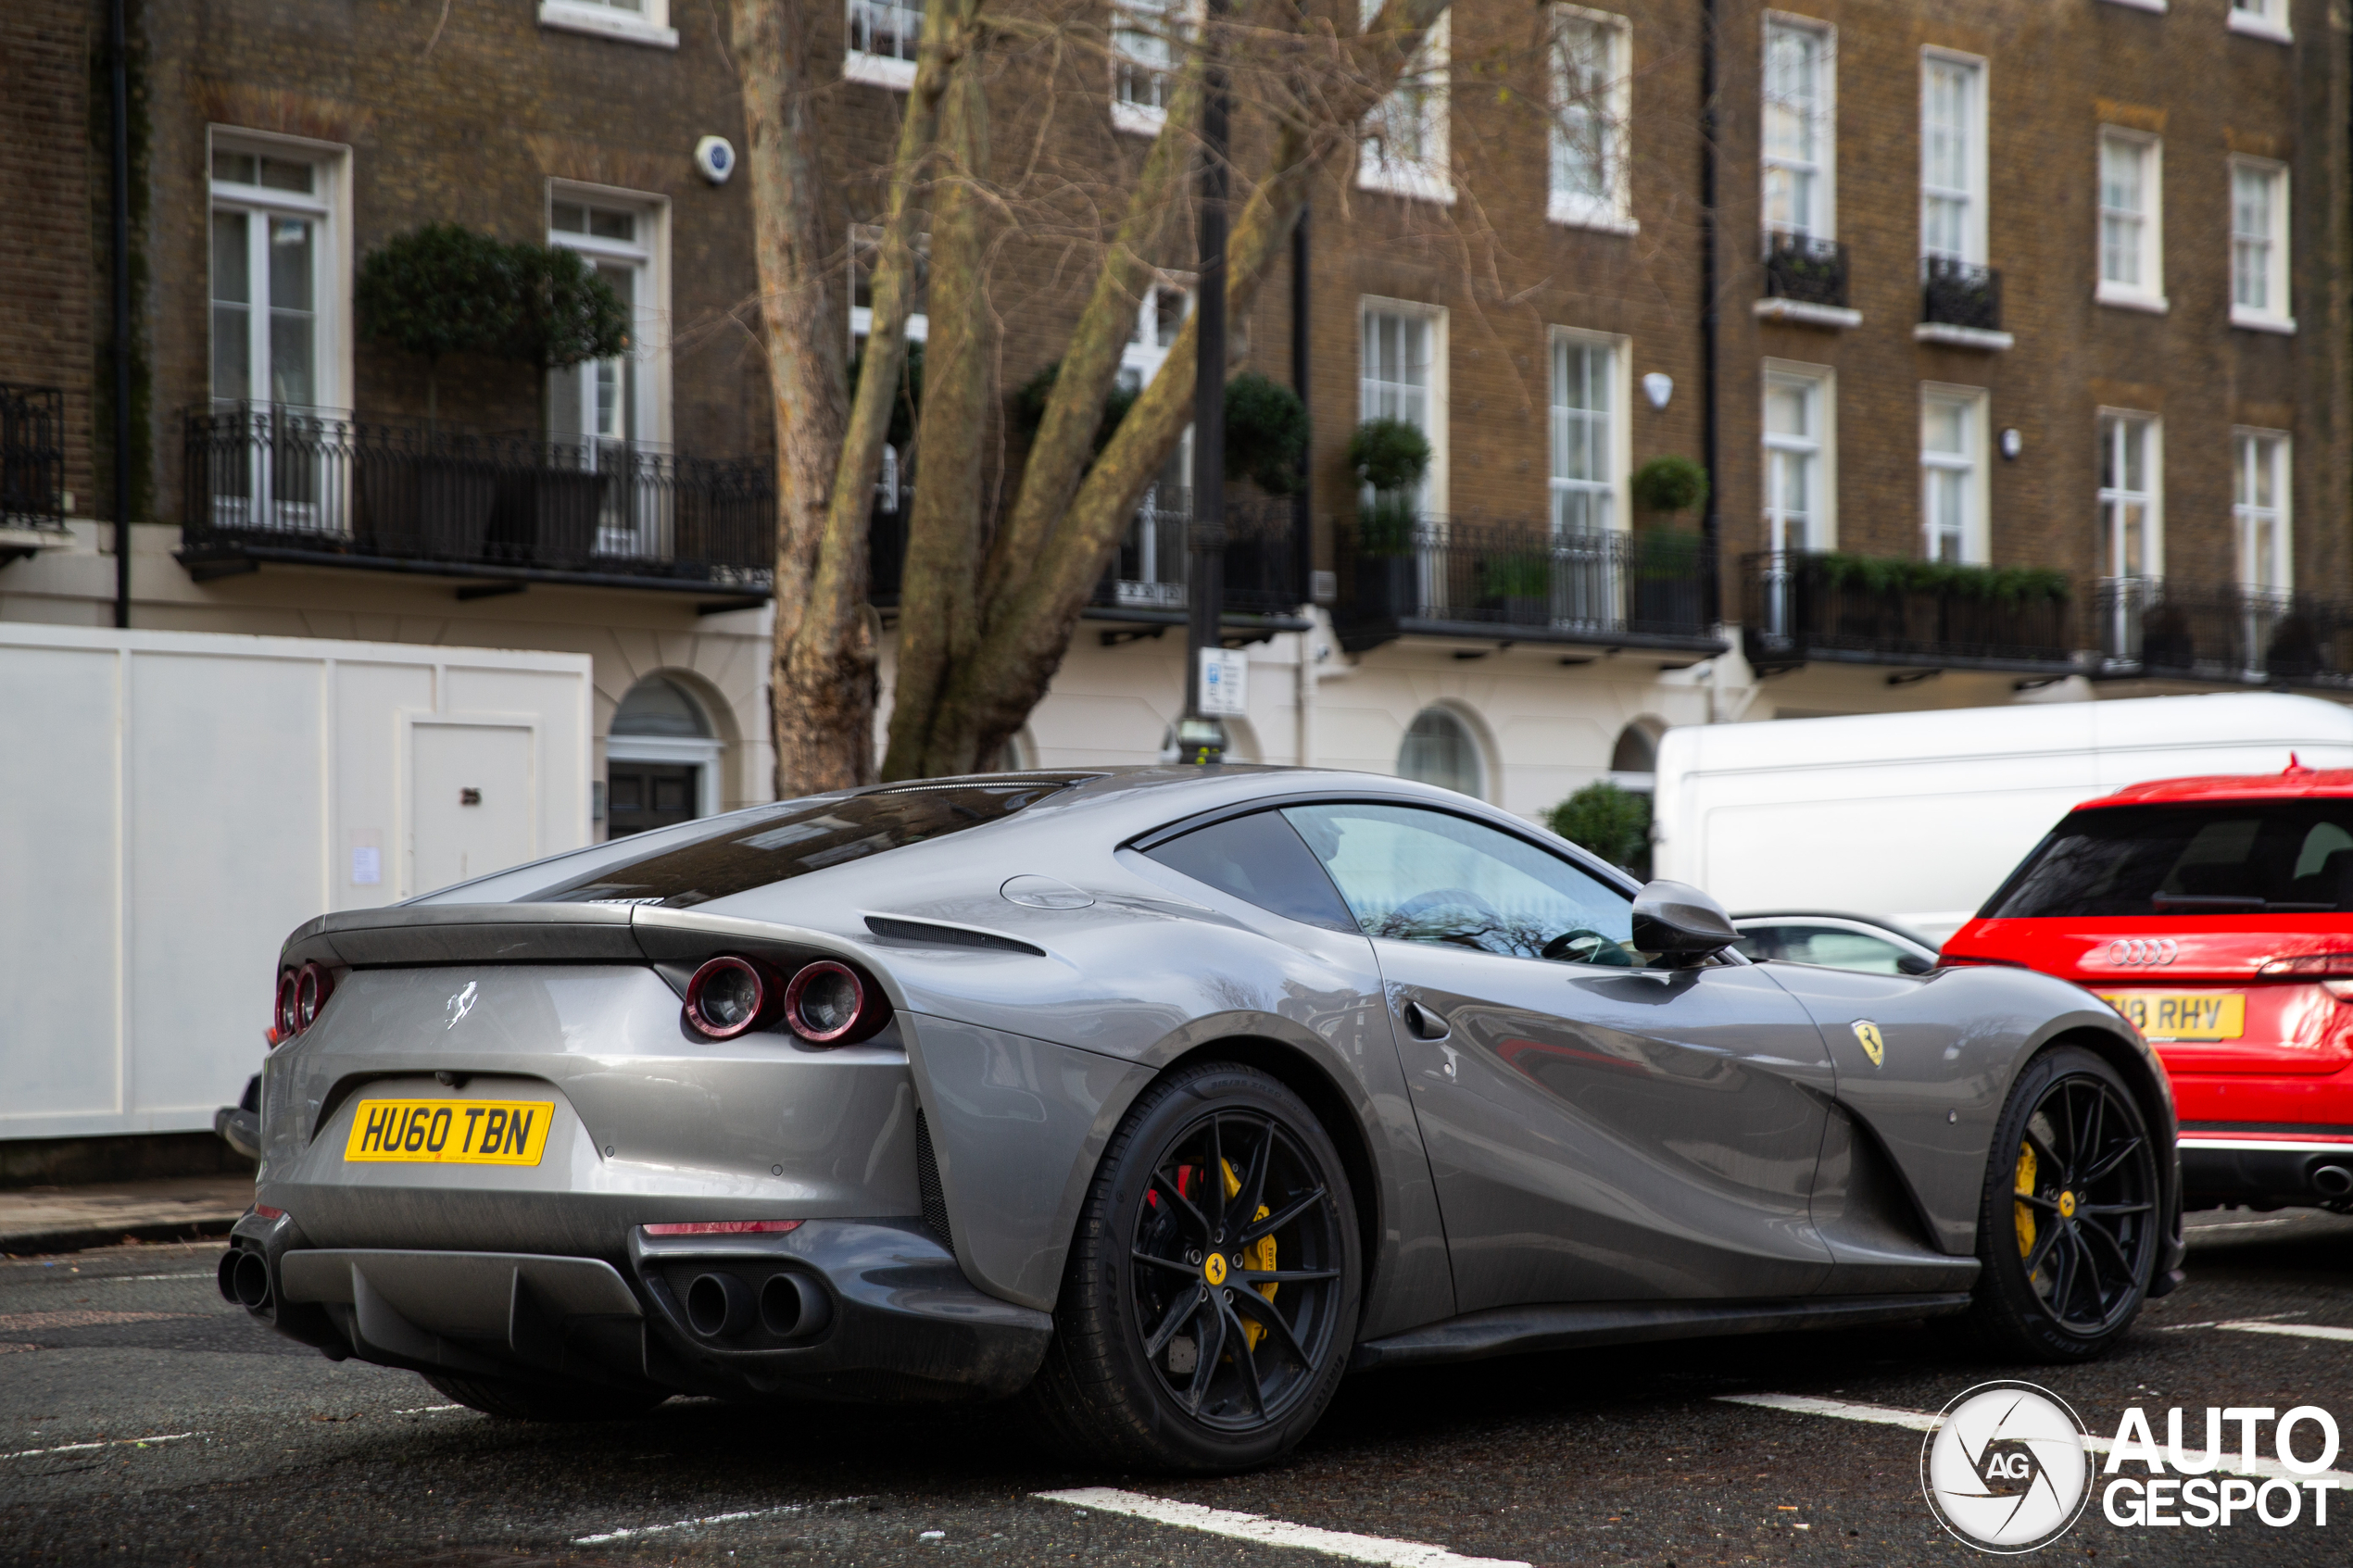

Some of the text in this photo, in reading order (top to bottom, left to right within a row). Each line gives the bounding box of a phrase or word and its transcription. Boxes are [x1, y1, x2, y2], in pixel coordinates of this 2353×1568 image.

[2158, 999, 2221, 1029] RHV
[360, 1107, 535, 1154] HU60 TBN
